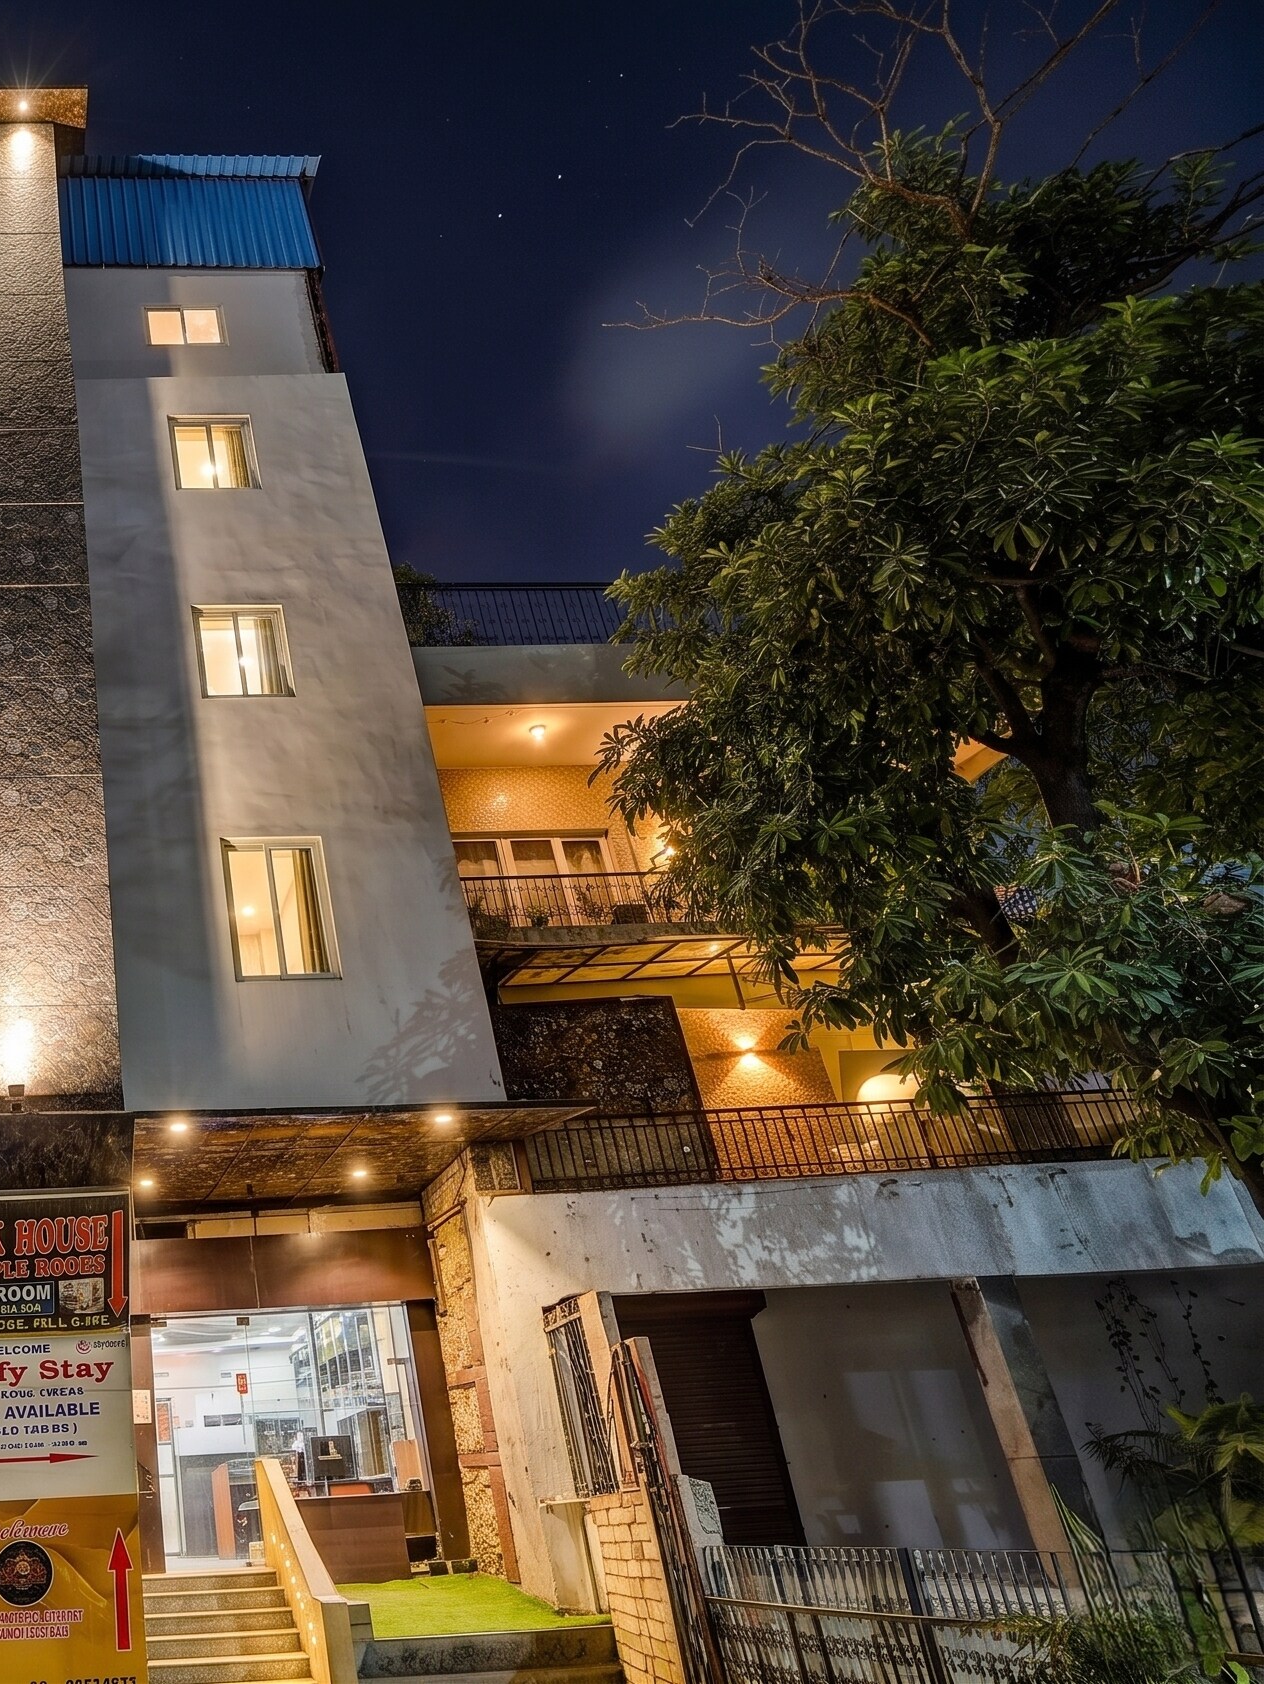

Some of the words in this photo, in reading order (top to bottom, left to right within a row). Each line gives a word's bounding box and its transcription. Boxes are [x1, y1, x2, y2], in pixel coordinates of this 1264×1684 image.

[14, 1214, 109, 1256] HOUSE
[39, 1359, 115, 1383] Stay
[4, 1402, 100, 1420] AVAILABLE
